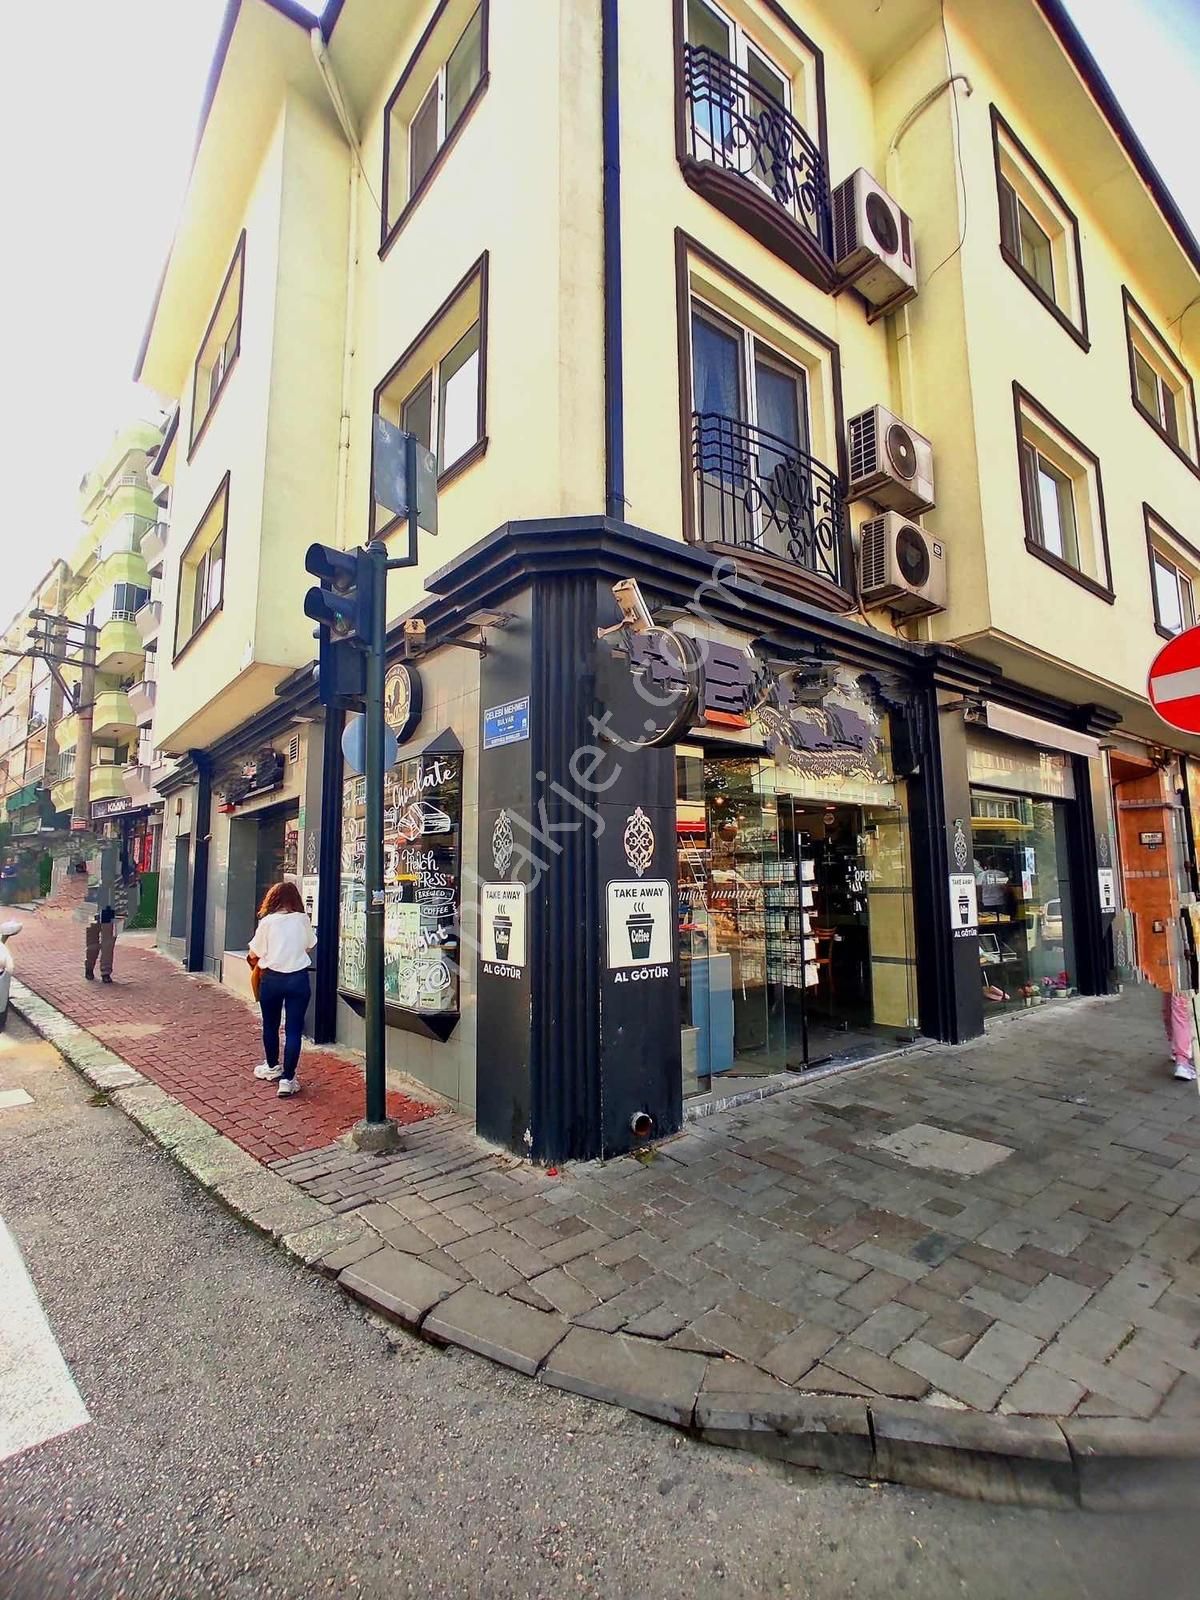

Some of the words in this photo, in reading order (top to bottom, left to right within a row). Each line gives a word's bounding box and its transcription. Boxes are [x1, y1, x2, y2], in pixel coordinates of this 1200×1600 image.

[504, 700, 527, 715] MEHMET
[855, 870, 875, 882] OPEN
[486, 890, 501, 899] TAKE
[503, 890, 521, 900] AWAY
[614, 888, 638, 898] TAKE
[640, 887, 664, 897] AWAY
[423, 906, 449, 916] COFFEE
[631, 928, 650, 944] Coffee
[954, 930, 961, 938] AL
[483, 963, 493, 974] AL
[494, 964, 521, 980] GÖTÜR
[614, 972, 629, 984] AL
[631, 966, 669, 982] GÖTÜR
